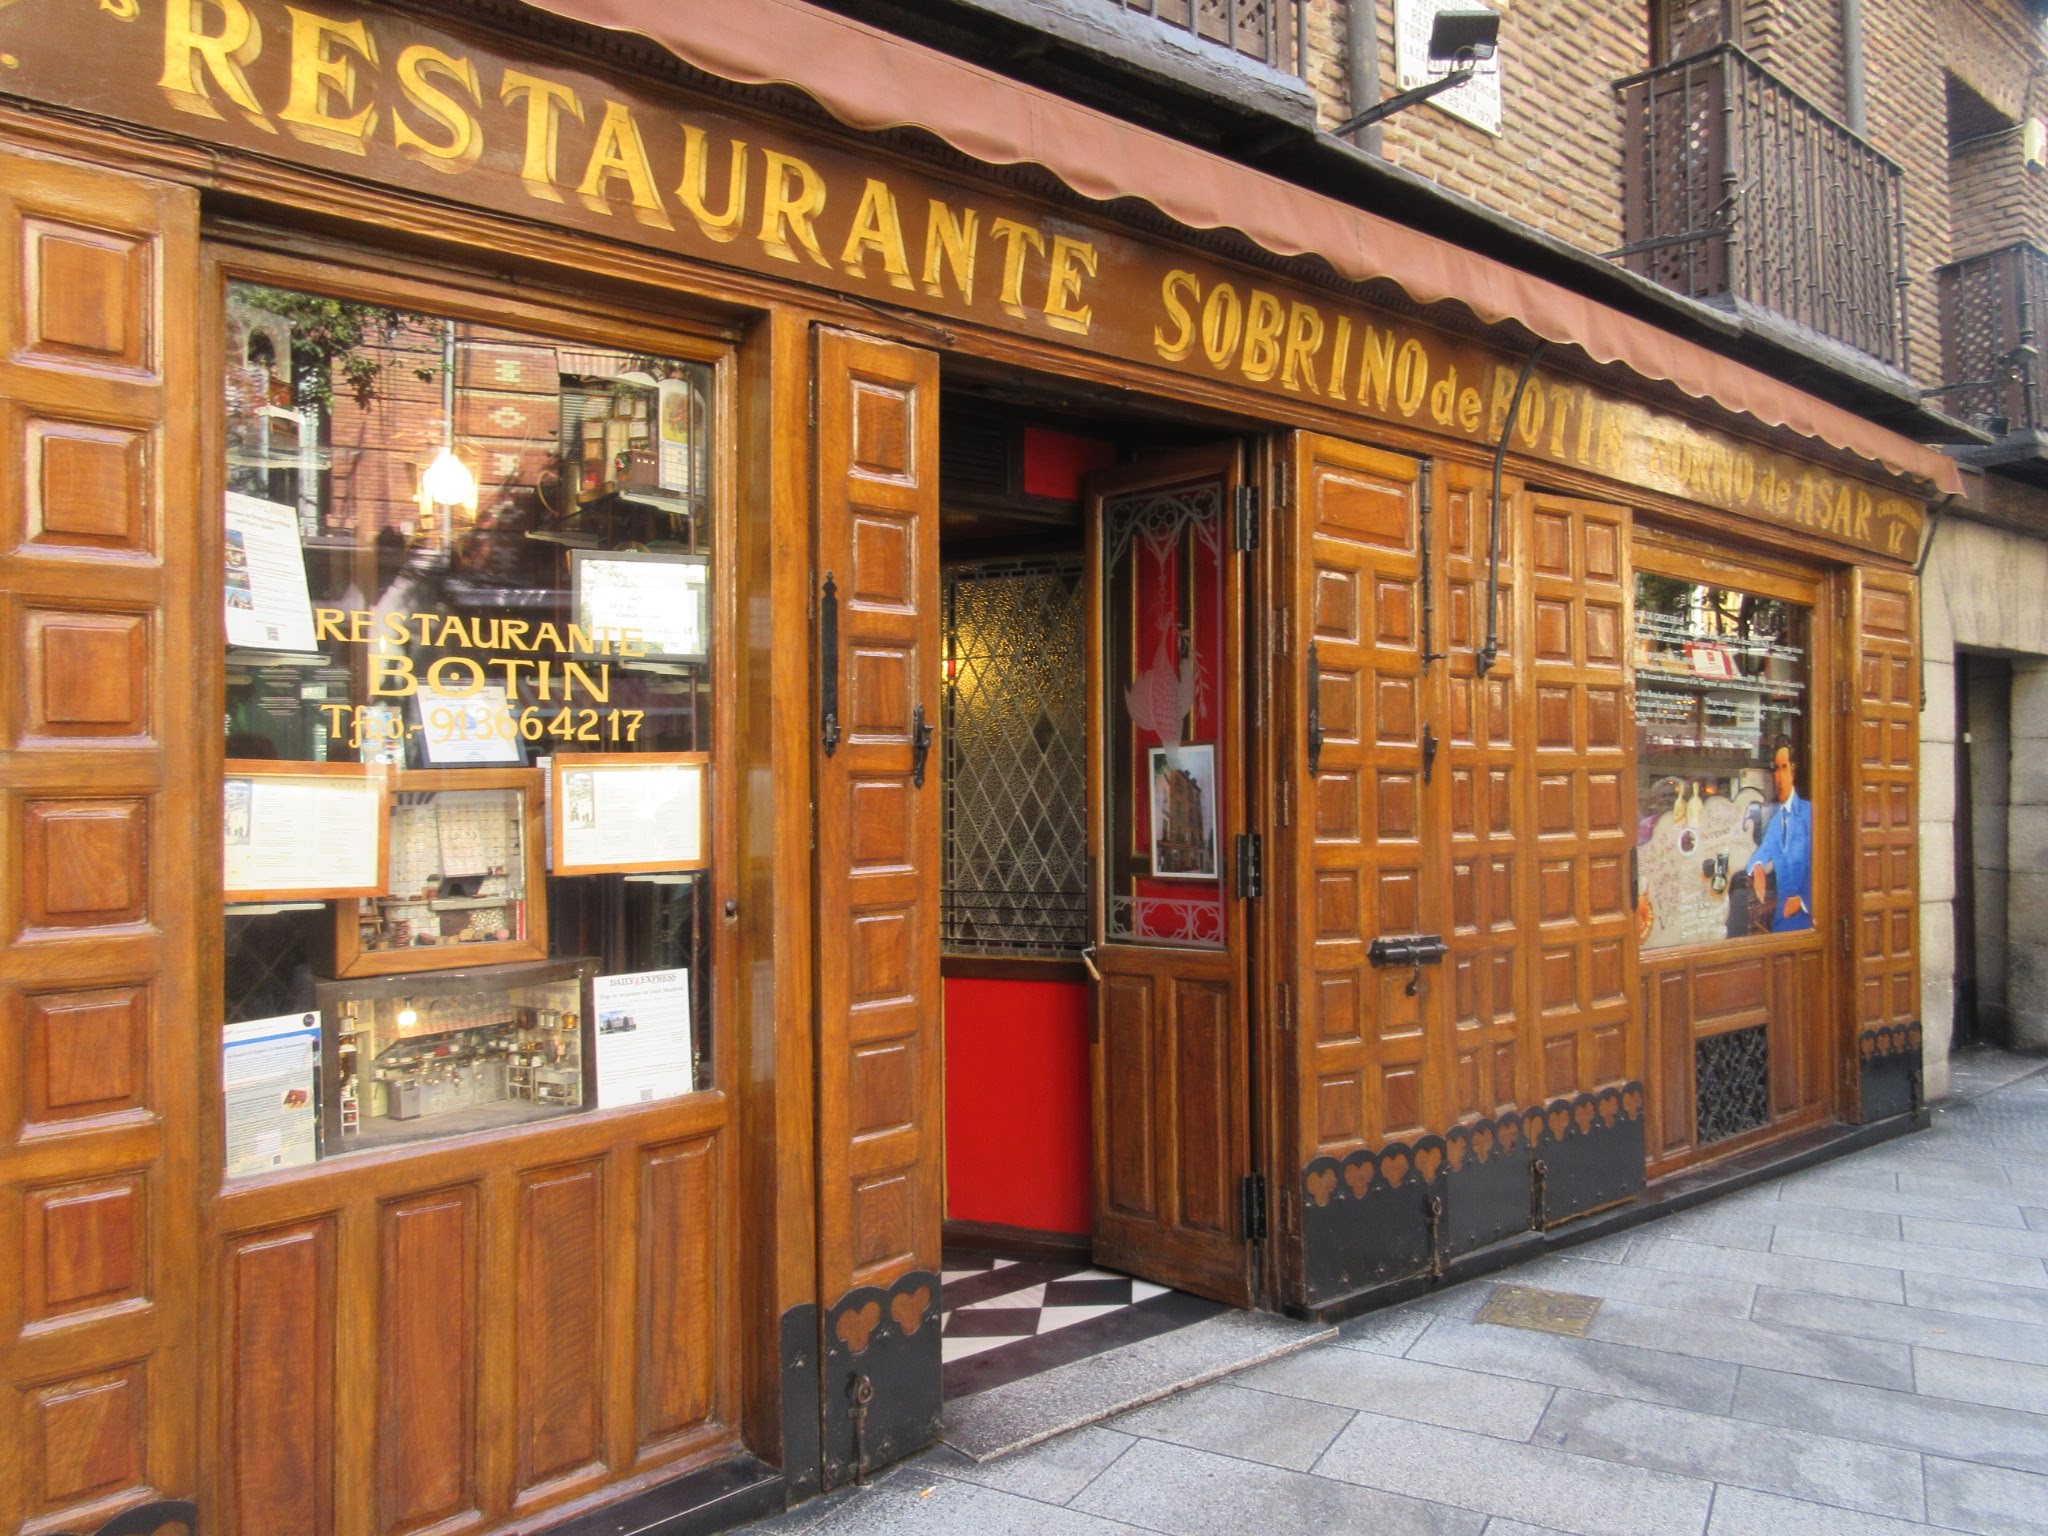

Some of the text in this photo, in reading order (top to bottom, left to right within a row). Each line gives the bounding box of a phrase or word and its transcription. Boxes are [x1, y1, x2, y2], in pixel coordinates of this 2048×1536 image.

[157, 0, 1098, 336] RESTAURANTE
[1154, 268, 1429, 417] SOBRINO
[1431, 364, 1482, 433] de
[1760, 464, 1791, 515] de
[1795, 470, 1873, 543] ASAR
[316, 608, 647, 658] RESTAURANTE
[368, 654, 610, 703] BOTIN
[609, 973, 677, 987] DAILY EXPRESS
